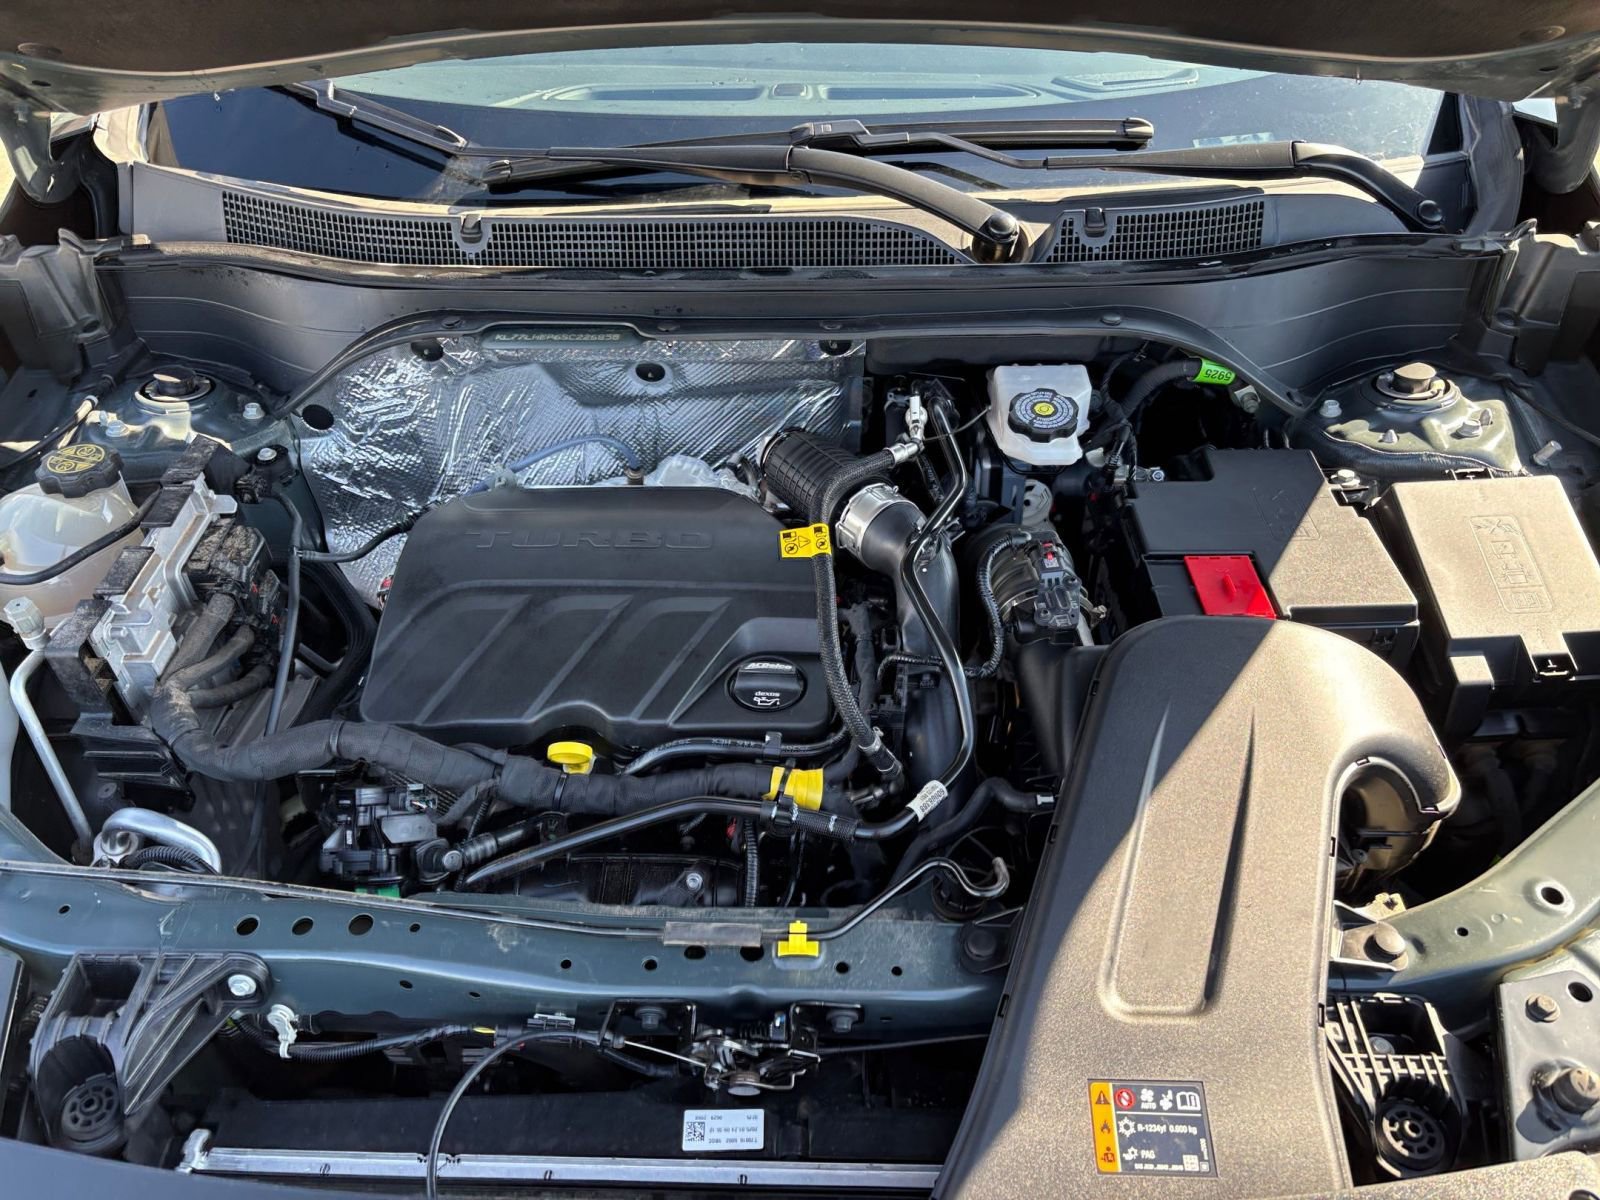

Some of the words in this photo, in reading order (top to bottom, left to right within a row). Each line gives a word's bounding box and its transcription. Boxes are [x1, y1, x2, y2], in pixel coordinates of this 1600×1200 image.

[1204, 369, 1232, 381] 5925
[464, 530, 713, 549] TURBO
[1141, 1102, 1157, 1110] AUTO
[1137, 1123, 1167, 1134] R-1234yf
[1188, 1125, 1198, 1135] kg
[1141, 1149, 1156, 1159] PAG
